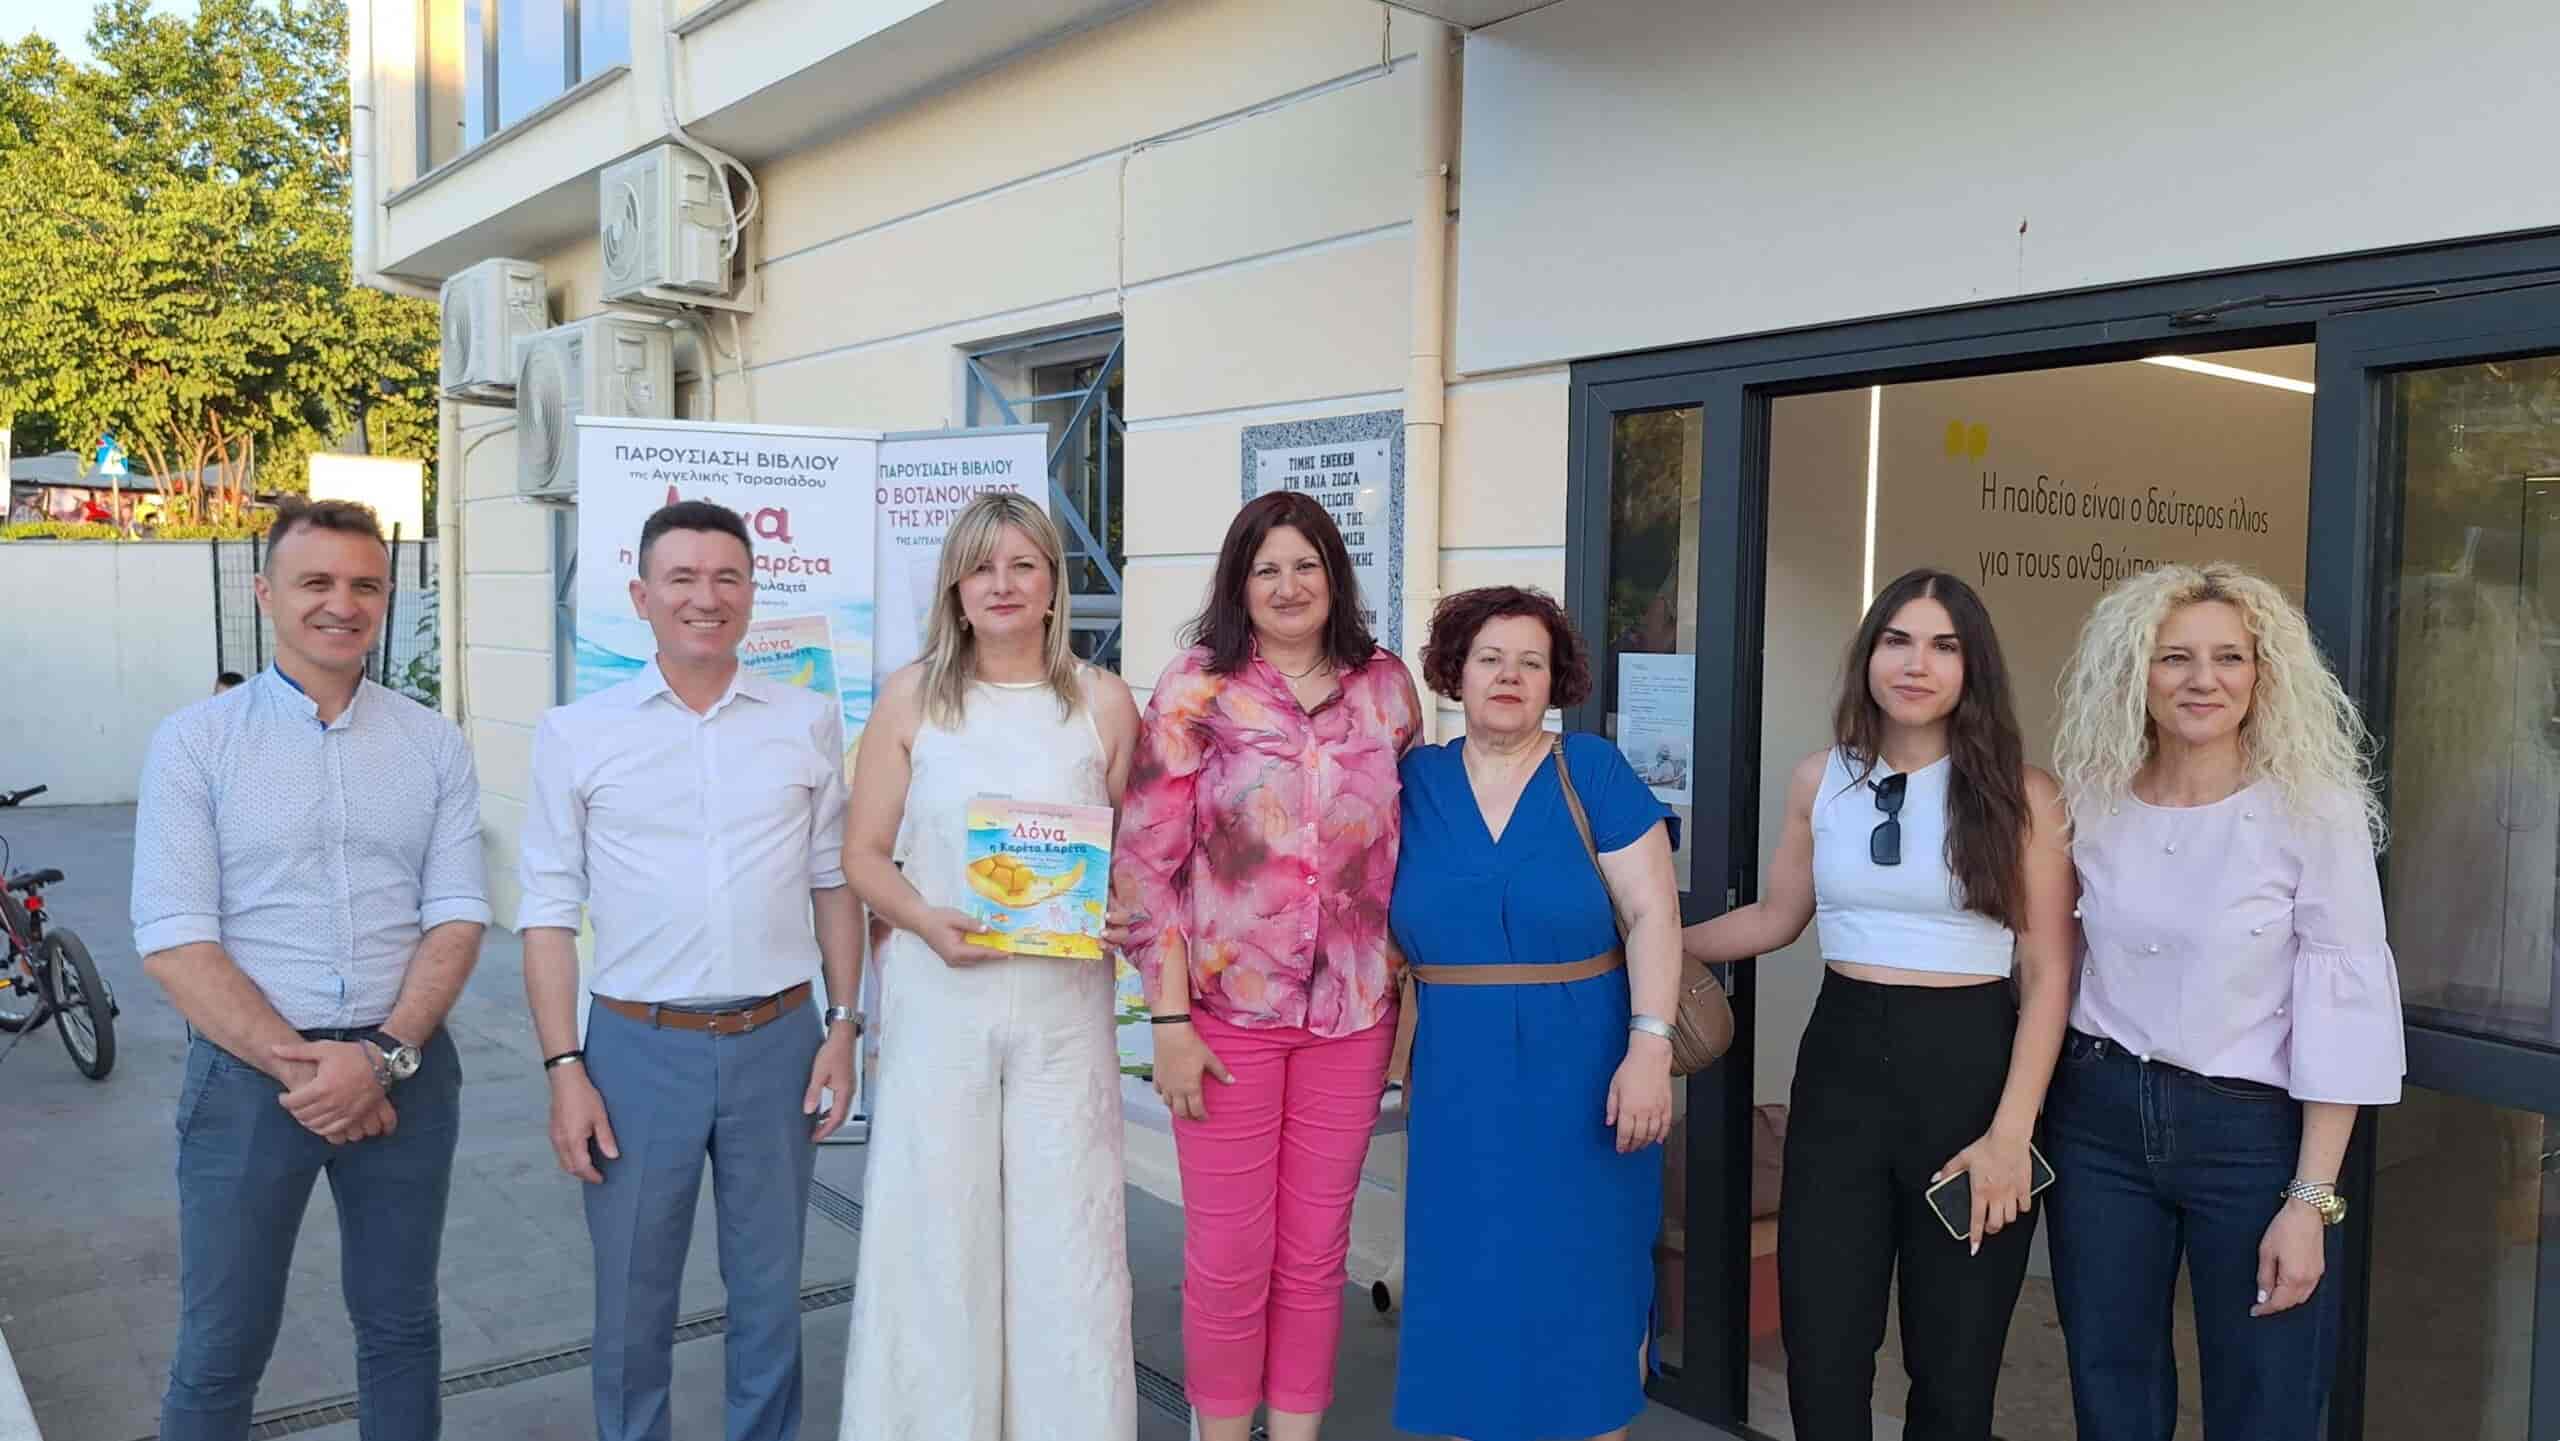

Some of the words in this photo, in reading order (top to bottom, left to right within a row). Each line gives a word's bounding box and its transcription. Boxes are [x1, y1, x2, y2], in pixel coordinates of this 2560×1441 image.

[615, 445, 749, 466] ΠΑΡΟΥΣΙΑΣΗ
[757, 452, 839, 471] ΒΙΒΛΙΟΥ
[879, 462, 958, 478] ΠΑΡΟΥΣΙΑΣΗ
[962, 459, 1013, 476] ΒΙΒΛΙΟΥ
[652, 469, 729, 485] Αγγελικής
[735, 472, 827, 488] Ταρασιάδου
[875, 487, 888, 504] Ο
[1982, 472, 1997, 510] Η
[2003, 475, 2076, 517] παιδεία
[2082, 481, 2125, 520] είναι
[2131, 498, 2142, 522] ο
[2147, 486, 2224, 536] δεύτερος
[2228, 497, 2269, 534] ήλιος
[888, 509, 919, 528] ΤΗΣ
[925, 508, 960, 527] ΧΡΙΣ
[753, 548, 832, 577] αρέτα
[1979, 552, 2008, 587] για
[2016, 552, 2060, 579] τους
[1013, 820, 1067, 842] Λόνα
